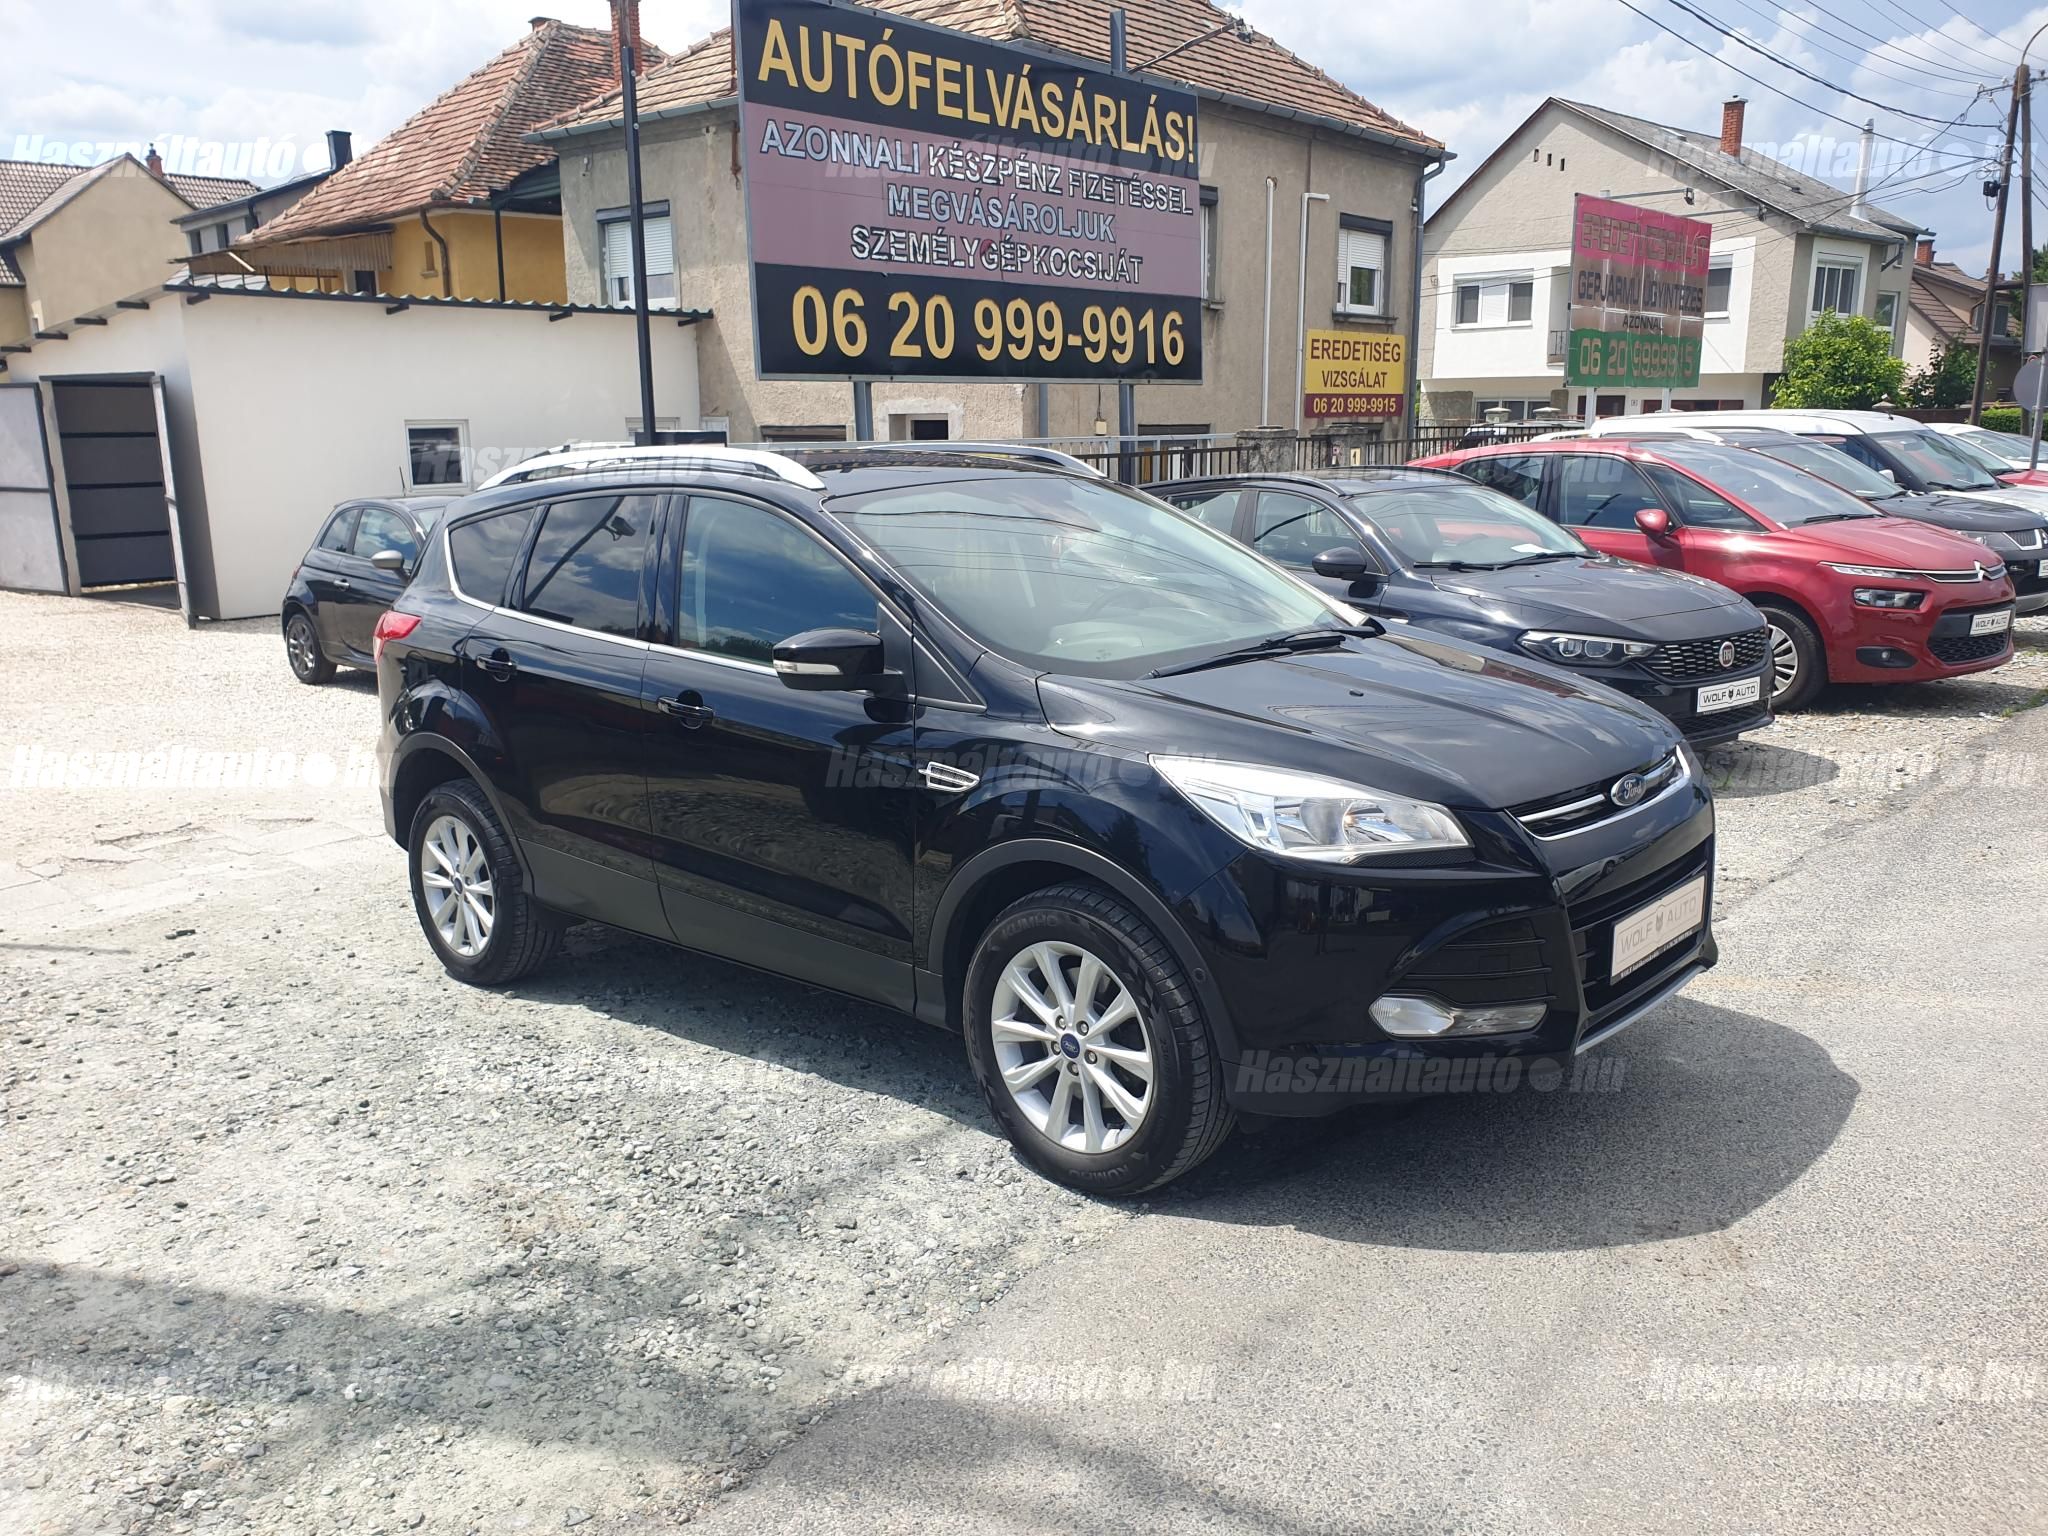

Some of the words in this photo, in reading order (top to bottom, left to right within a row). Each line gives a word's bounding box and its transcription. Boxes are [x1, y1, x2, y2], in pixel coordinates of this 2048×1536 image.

[758, 19, 1195, 164] AUTÓFELVÁSÁRLÁS!
[761, 119, 919, 174] AZONNALI
[928, 142, 1063, 196] KÉSZPÉNZ
[1067, 168, 1194, 215] FIZETÉSSEL
[888, 183, 1117, 243] MEGVÁSÁROLJUK
[851, 223, 1143, 284] SZEMÉLYGÉPKOCSIJÁT
[792, 285, 868, 358] 06
[888, 291, 955, 359] 20
[974, 297, 1185, 366] 999-9916
[1310, 337, 1401, 362] EREDETISÉG
[1322, 367, 1387, 388] VIZSGÁLAT
[1580, 338, 1602, 375] 06
[1607, 338, 1628, 376] 20
[1313, 398, 1328, 413] 06
[1330, 398, 1344, 413] 20
[1347, 397, 1396, 412] 999-9915
[1703, 691, 1727, 703] WOLF
[1736, 685, 1756, 696] AUTO
[1617, 778, 1643, 800] Ford
[1621, 921, 1653, 954] WOLF
[1667, 895, 1697, 922] AUTO
